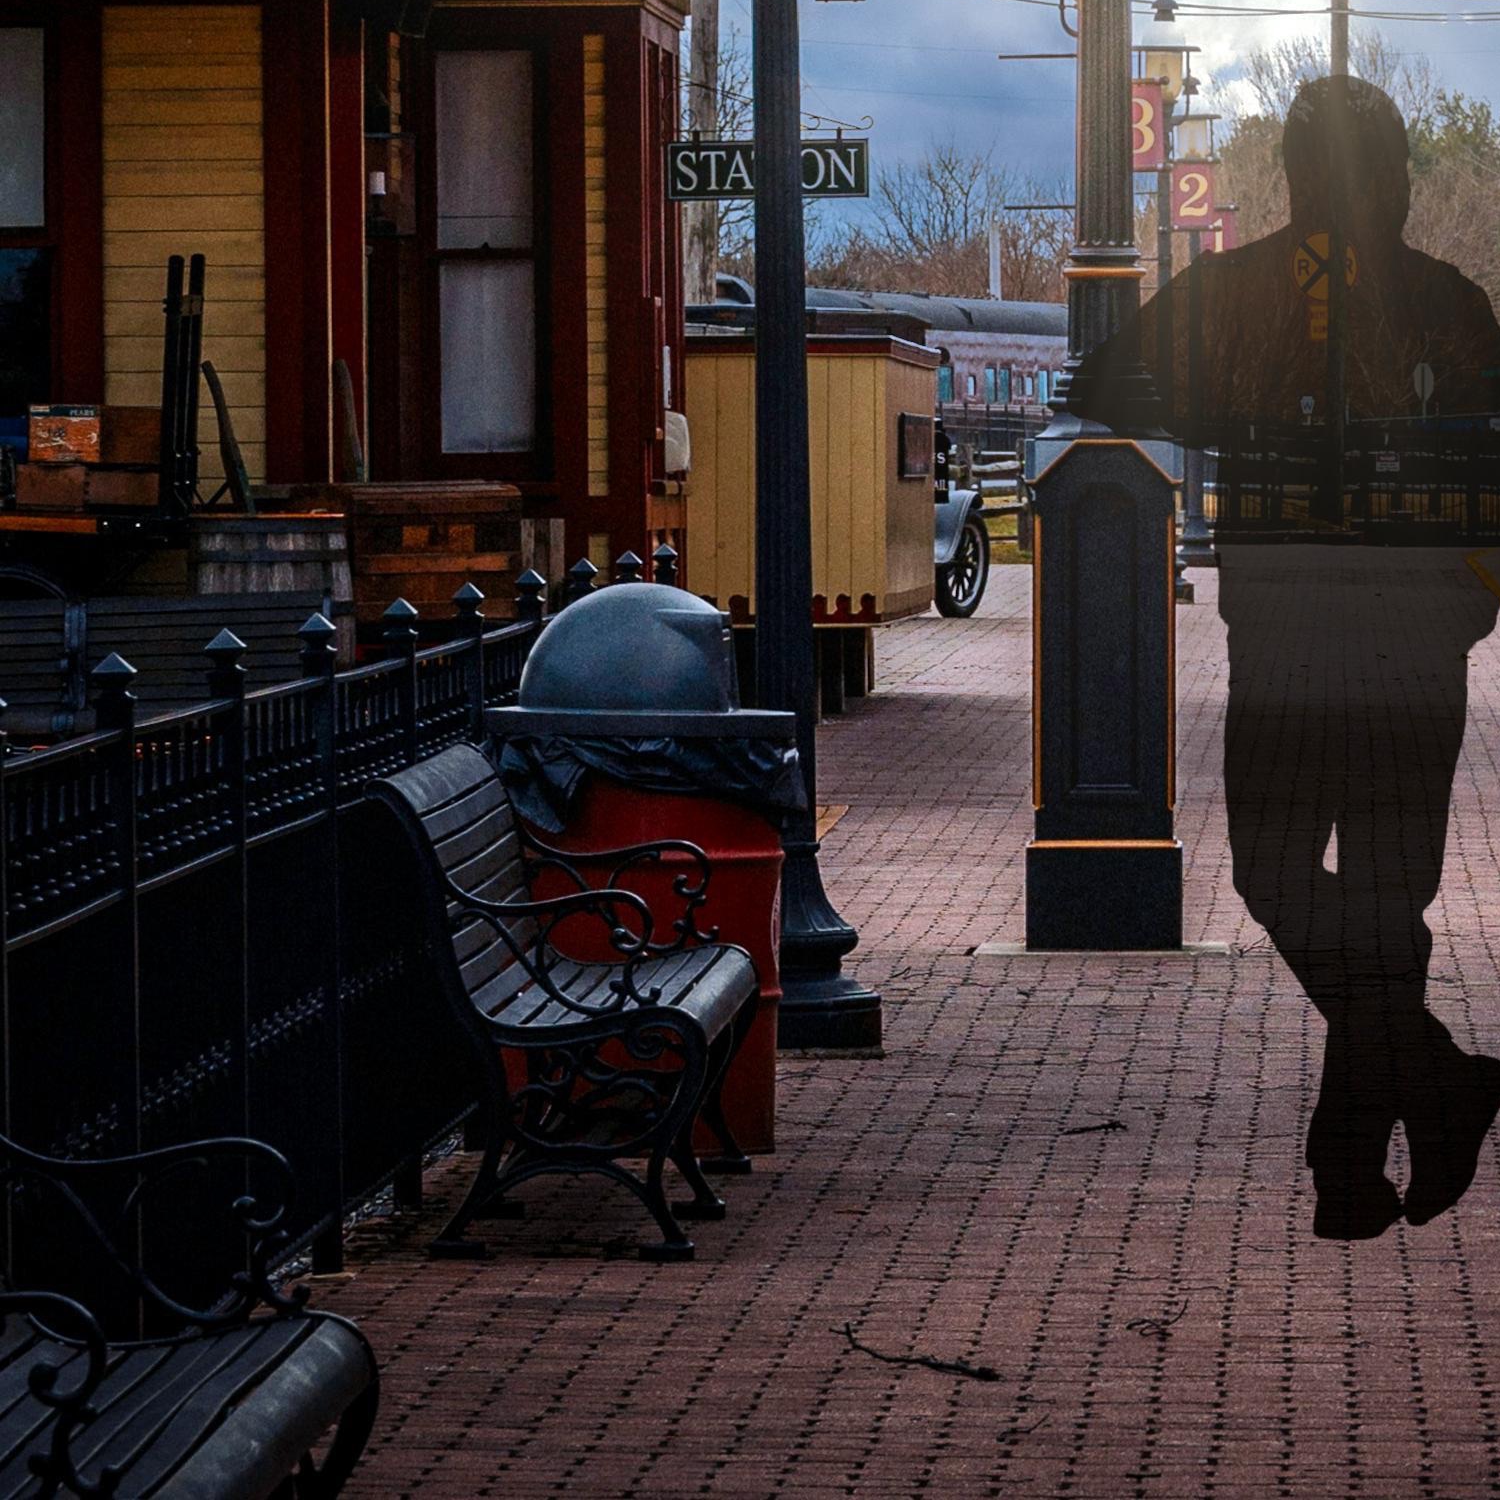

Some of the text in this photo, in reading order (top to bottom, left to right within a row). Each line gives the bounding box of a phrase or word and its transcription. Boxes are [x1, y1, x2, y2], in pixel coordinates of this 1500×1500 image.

[1132, 98, 1156, 155] 3
[676, 148, 859, 192] STAON
[1179, 173, 1209, 218] 2
[1297, 259, 1310, 277] R
